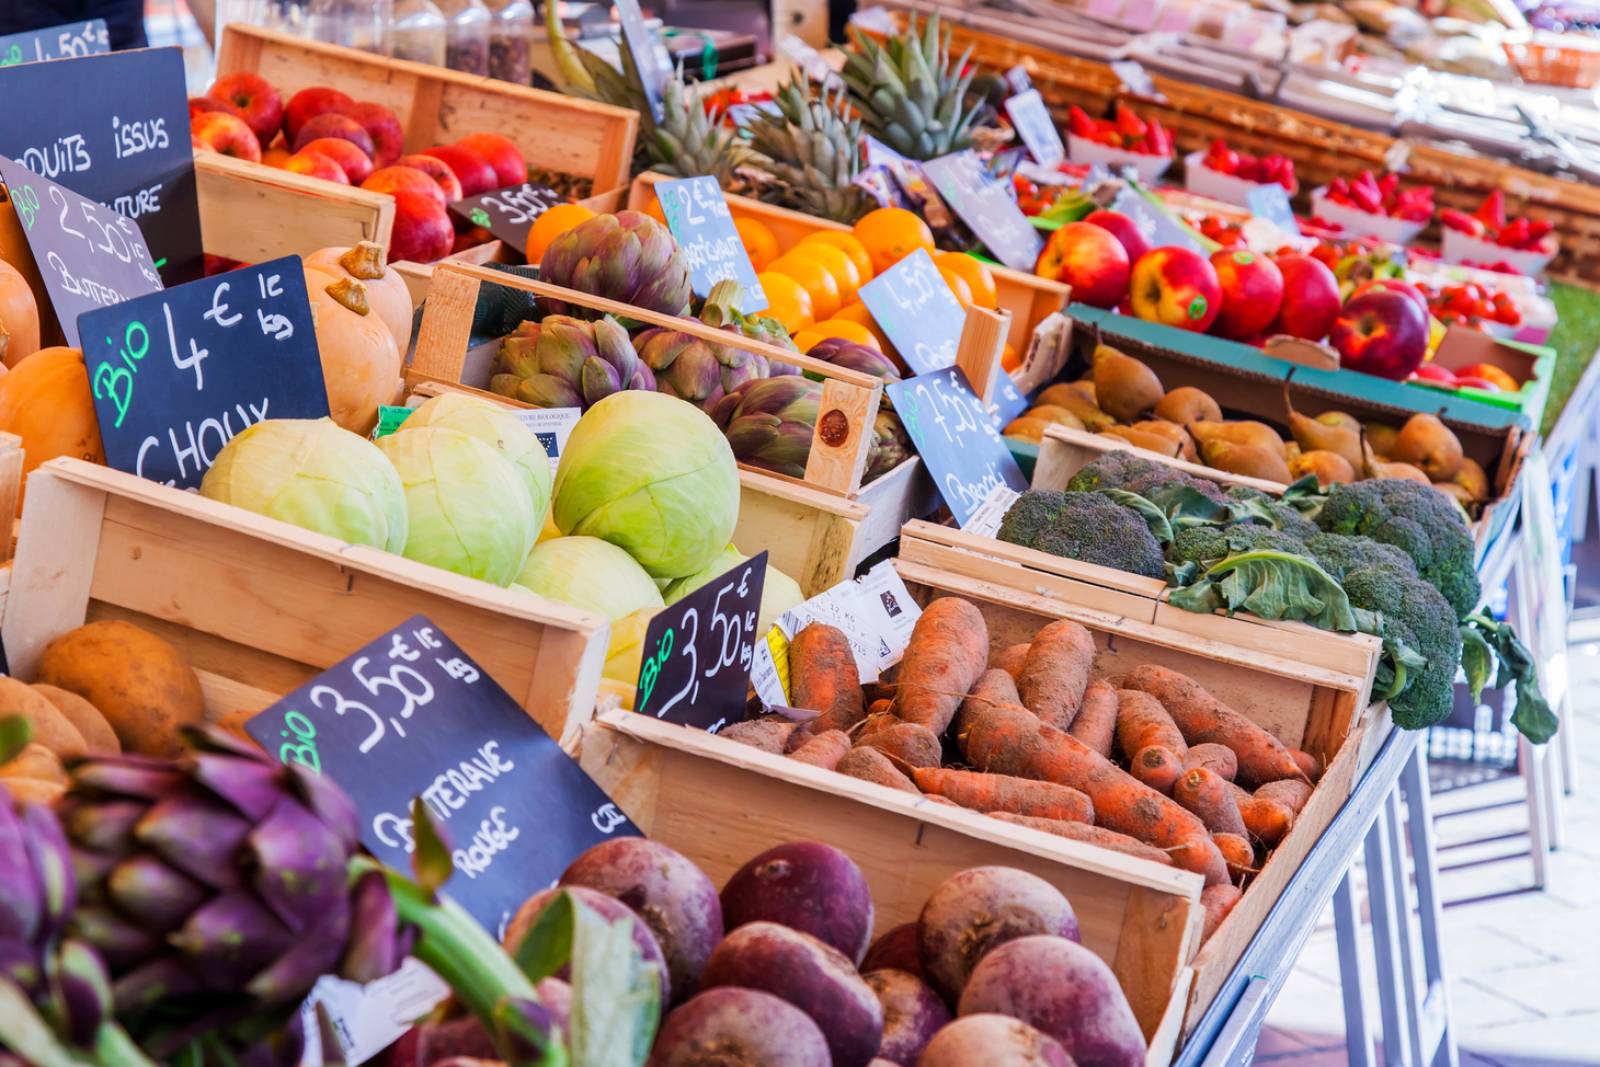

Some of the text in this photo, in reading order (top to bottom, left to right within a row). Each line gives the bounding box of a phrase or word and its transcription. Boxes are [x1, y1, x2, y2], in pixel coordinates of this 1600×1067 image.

[47, 252, 130, 306] BUTTER
[164, 302, 208, 390] 4
[203, 282, 242, 326] €
[257, 309, 293, 340] kg
[373, 740, 515, 853] BTTERAVE
